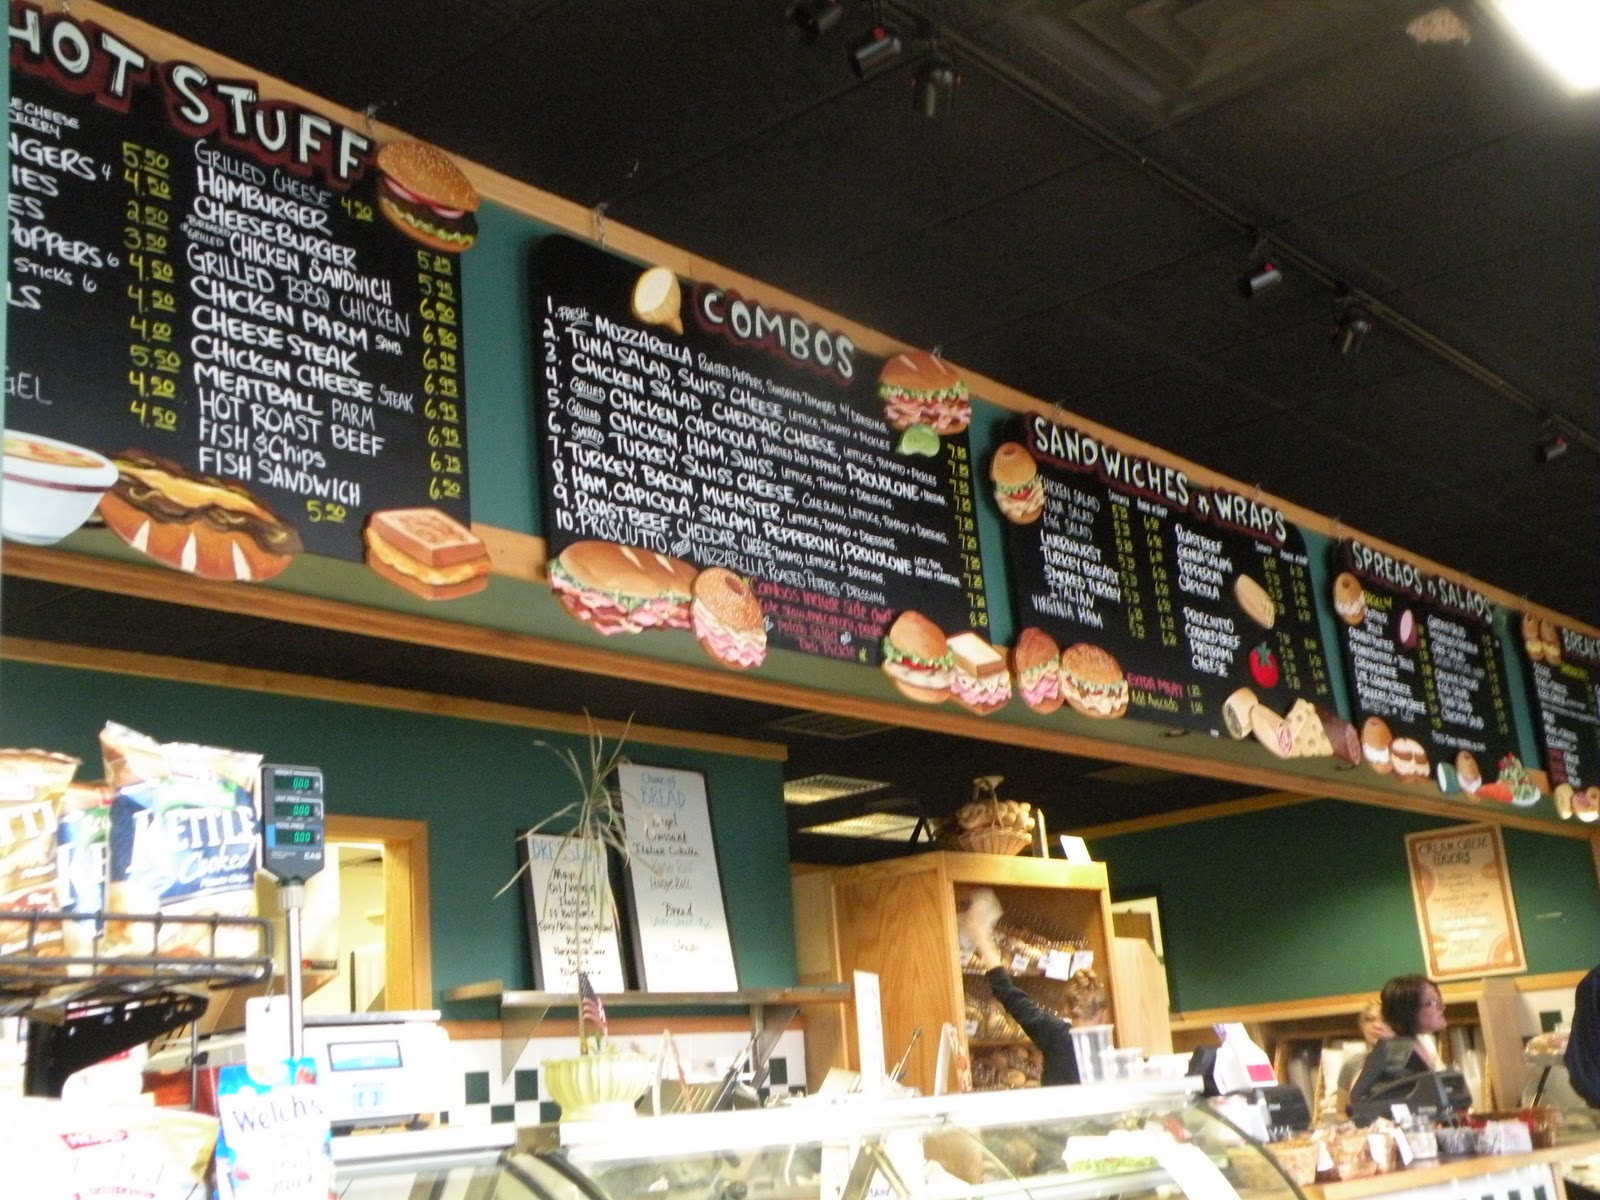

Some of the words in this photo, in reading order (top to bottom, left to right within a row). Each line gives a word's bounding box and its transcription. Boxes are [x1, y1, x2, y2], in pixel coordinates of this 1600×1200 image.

[172, 64, 369, 179] STUFF
[194, 138, 267, 187] GRILLED
[272, 168, 333, 210] CHEESE
[196, 165, 334, 237] HAMBURGER
[193, 196, 357, 271] CHEESEBURGER
[229, 231, 300, 275] CHICKEN
[308, 260, 393, 307] SANDWICH
[14, 257, 73, 287] STICKS
[187, 243, 276, 294] GRILLED
[281, 274, 331, 311] BBQ
[339, 294, 411, 338] CHICKEN
[190, 275, 295, 328] CHICKEN
[302, 309, 369, 352] PARM
[191, 304, 285, 351] CHEESE
[286, 333, 362, 378] STEAK
[594, 314, 693, 367] MOZZARELLA
[703, 288, 855, 380] COMBOS
[190, 335, 291, 382] CHICKEN
[296, 364, 375, 403] CHEESE
[377, 384, 415, 415] STEAK
[193, 361, 324, 417] MEATBALL
[331, 398, 376, 432] PARM
[564, 326, 615, 363] TUNA
[677, 367, 727, 400] SWISS
[571, 352, 646, 395] CHICKEN
[711, 401, 782, 442] CHEDDAR
[199, 387, 246, 422] HOT
[250, 403, 324, 445] ROAST
[330, 424, 386, 457] BEEF
[199, 416, 250, 452] FISH
[199, 445, 251, 481] FISH
[257, 459, 361, 507] SANDWICH
[680, 453, 734, 487] SWISS
[845, 461, 920, 502] PROVOLONE
[1033, 415, 1190, 507] SANDWICHES
[1213, 491, 1288, 544] WRAPS
[676, 518, 740, 551] CHEDDAR
[842, 540, 914, 576] PROVOLONE
[1039, 545, 1082, 574] TURKEY
[1081, 558, 1120, 587] BREAST
[1030, 592, 1076, 622] VIRGINIA
[1077, 605, 1105, 630] HAM
[1043, 563, 1087, 592] SMOKED
[1047, 579, 1096, 610] ITALIAN
[1351, 540, 1423, 597] SPREADS
[1437, 576, 1494, 626] SALADS
